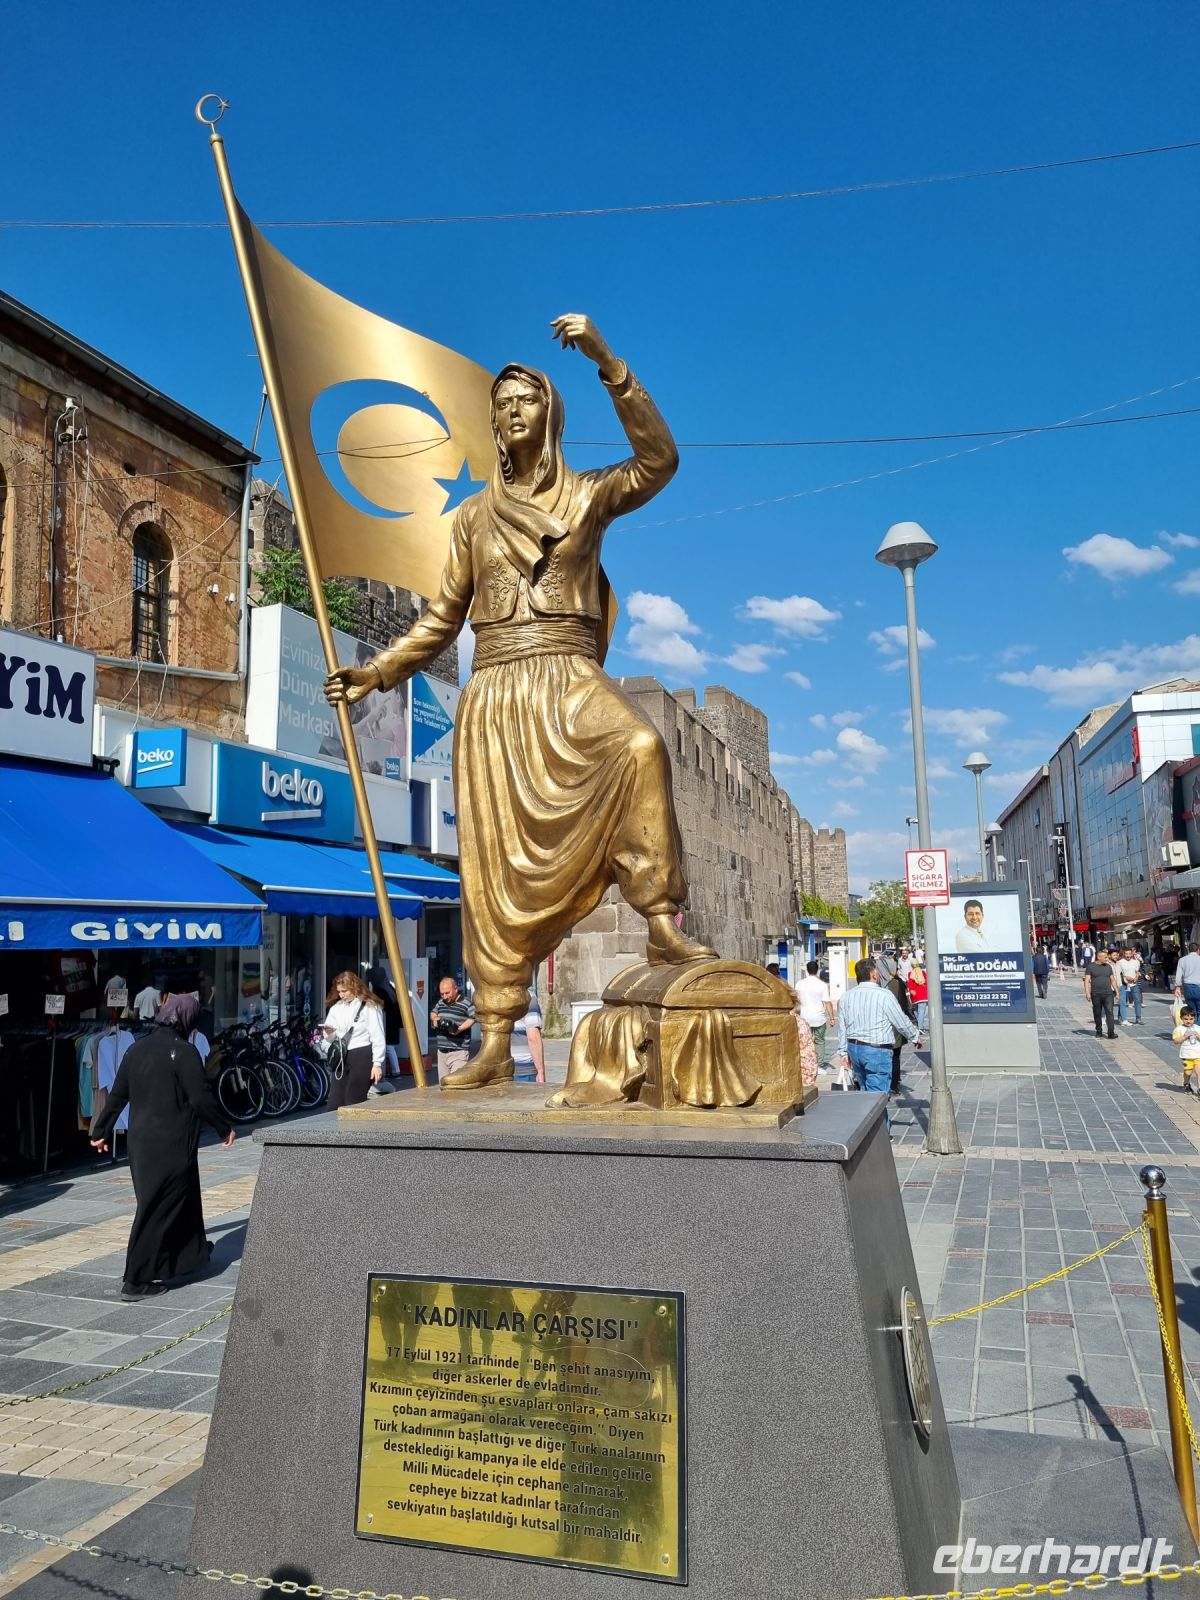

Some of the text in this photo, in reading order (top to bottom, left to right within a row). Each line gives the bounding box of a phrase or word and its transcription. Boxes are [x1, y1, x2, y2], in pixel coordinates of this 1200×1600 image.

[279, 700, 334, 738] Markası
[137, 748, 174, 764] beko
[386, 761, 399, 772] beko
[262, 761, 323, 806] beko
[912, 880, 944, 888] İÇİLMEZ
[70, 917, 223, 941] GİYİM
[944, 958, 1017, 972] Murat DOĞAN
[402, 1304, 638, 1344] "KADINLAR ÇARŞISI"
[387, 1346, 655, 1384] 17 Eylül 1921 tarihinde "Ben şehit anasıyım,
[432, 1369, 600, 1396] diğer askerler de evladımdır.
[370, 1382, 672, 1424] Kızımın çeyizinden şu esvapları onlara, çam sakızı
[374, 1419, 666, 1463] Türk kadınının başlattığı ve diğer Türk analarının
[392, 1404, 427, 1417] çoban
[430, 1408, 485, 1424] armağanı
[488, 1412, 526, 1428] olarak
[608, 1425, 644, 1442] Diyen
[384, 1439, 454, 1460] desteklediği
[458, 1447, 518, 1468] kampanya
[522, 1454, 536, 1468] ile
[540, 1457, 566, 1472] elde
[570, 1462, 608, 1476] edilen
[403, 1460, 628, 1501] Milli Mücadele için cephane alınarak,
[409, 1482, 620, 1519] cepheye bizzat kadınlar tarafından
[387, 1498, 644, 1544] sevkiyatın başlatıldığı kutsal bir mahaldir.
